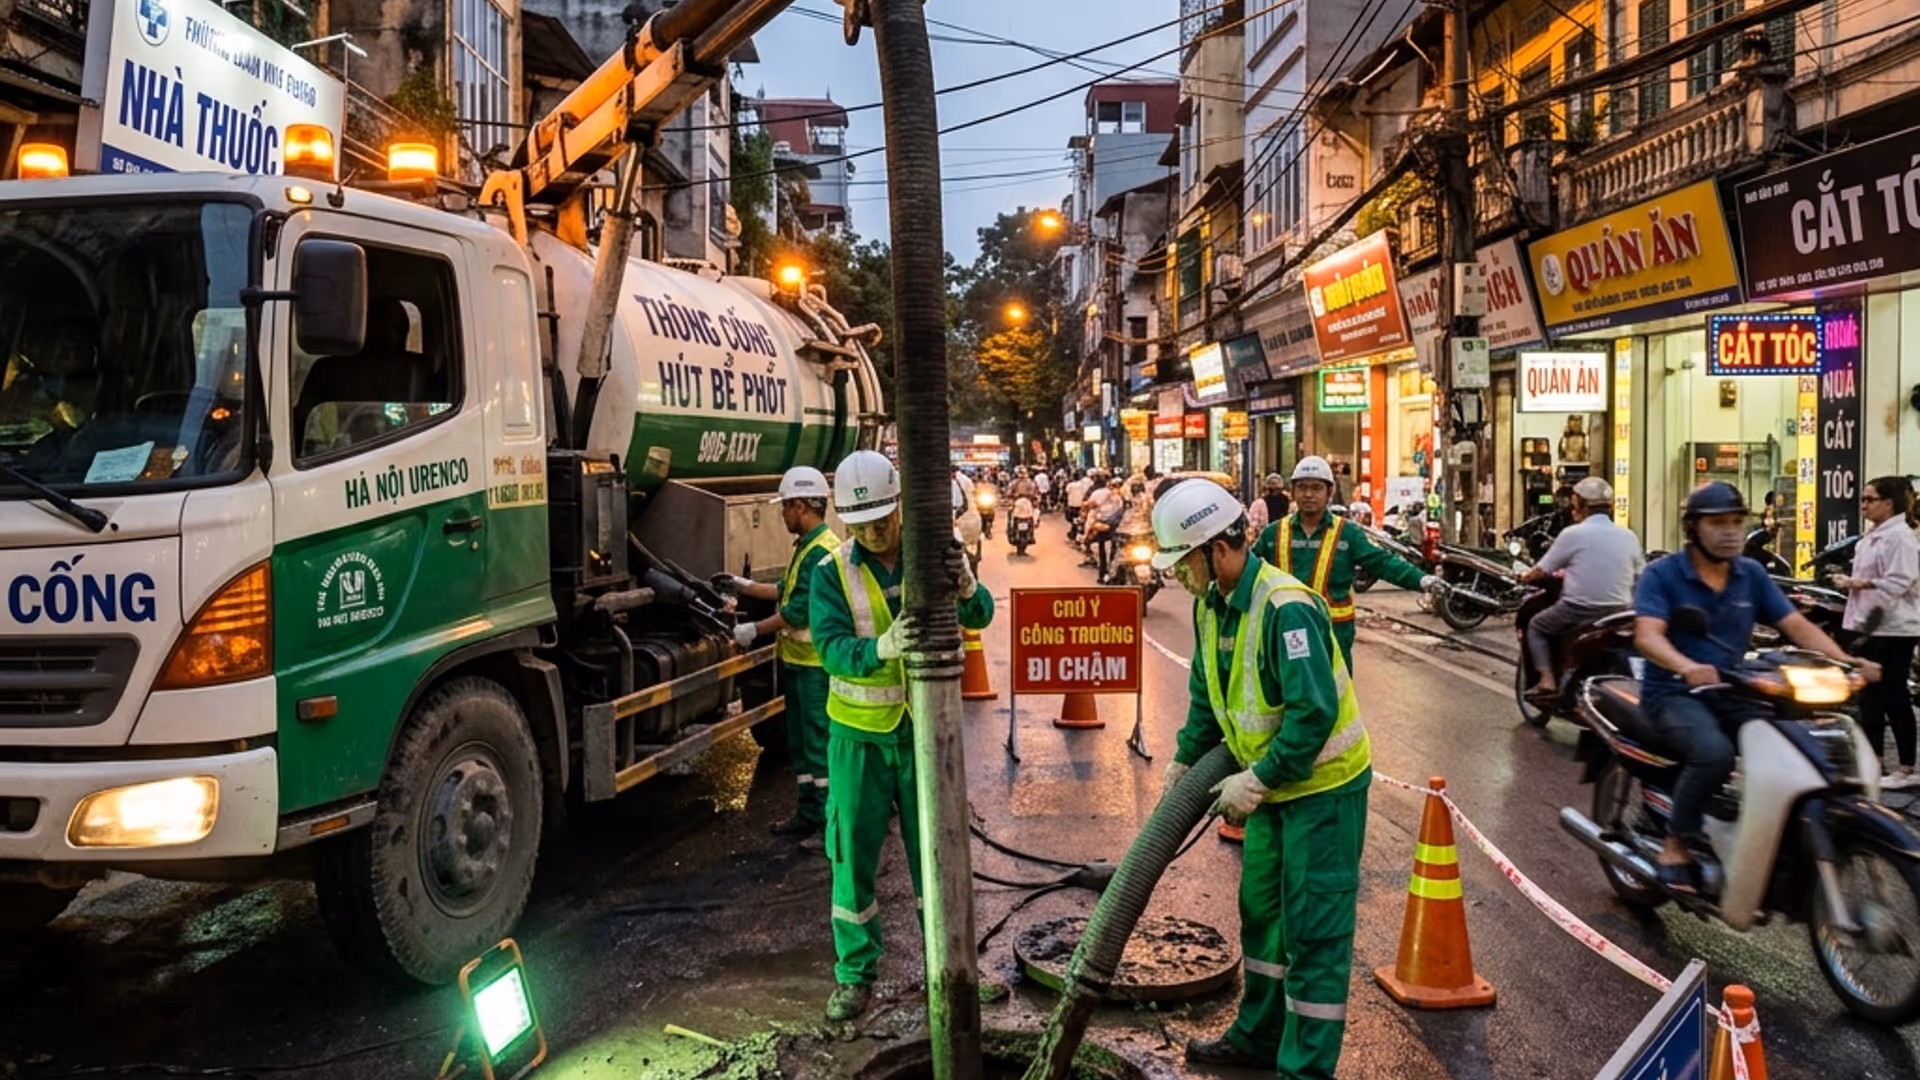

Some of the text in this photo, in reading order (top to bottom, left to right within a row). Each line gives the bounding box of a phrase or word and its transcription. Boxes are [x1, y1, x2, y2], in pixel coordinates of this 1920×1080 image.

[119, 58, 184, 148] NHÀ
[1791, 169, 1865, 254] CẮT
[1770, 323, 1816, 365] TÓC
[658, 352, 702, 409] HÚT
[409, 457, 469, 495] URENCO
[1823, 464, 1854, 499] TÓC
[8, 553, 157, 624] CỐNG
[1027, 651, 1127, 686] ĐI CHẬM
